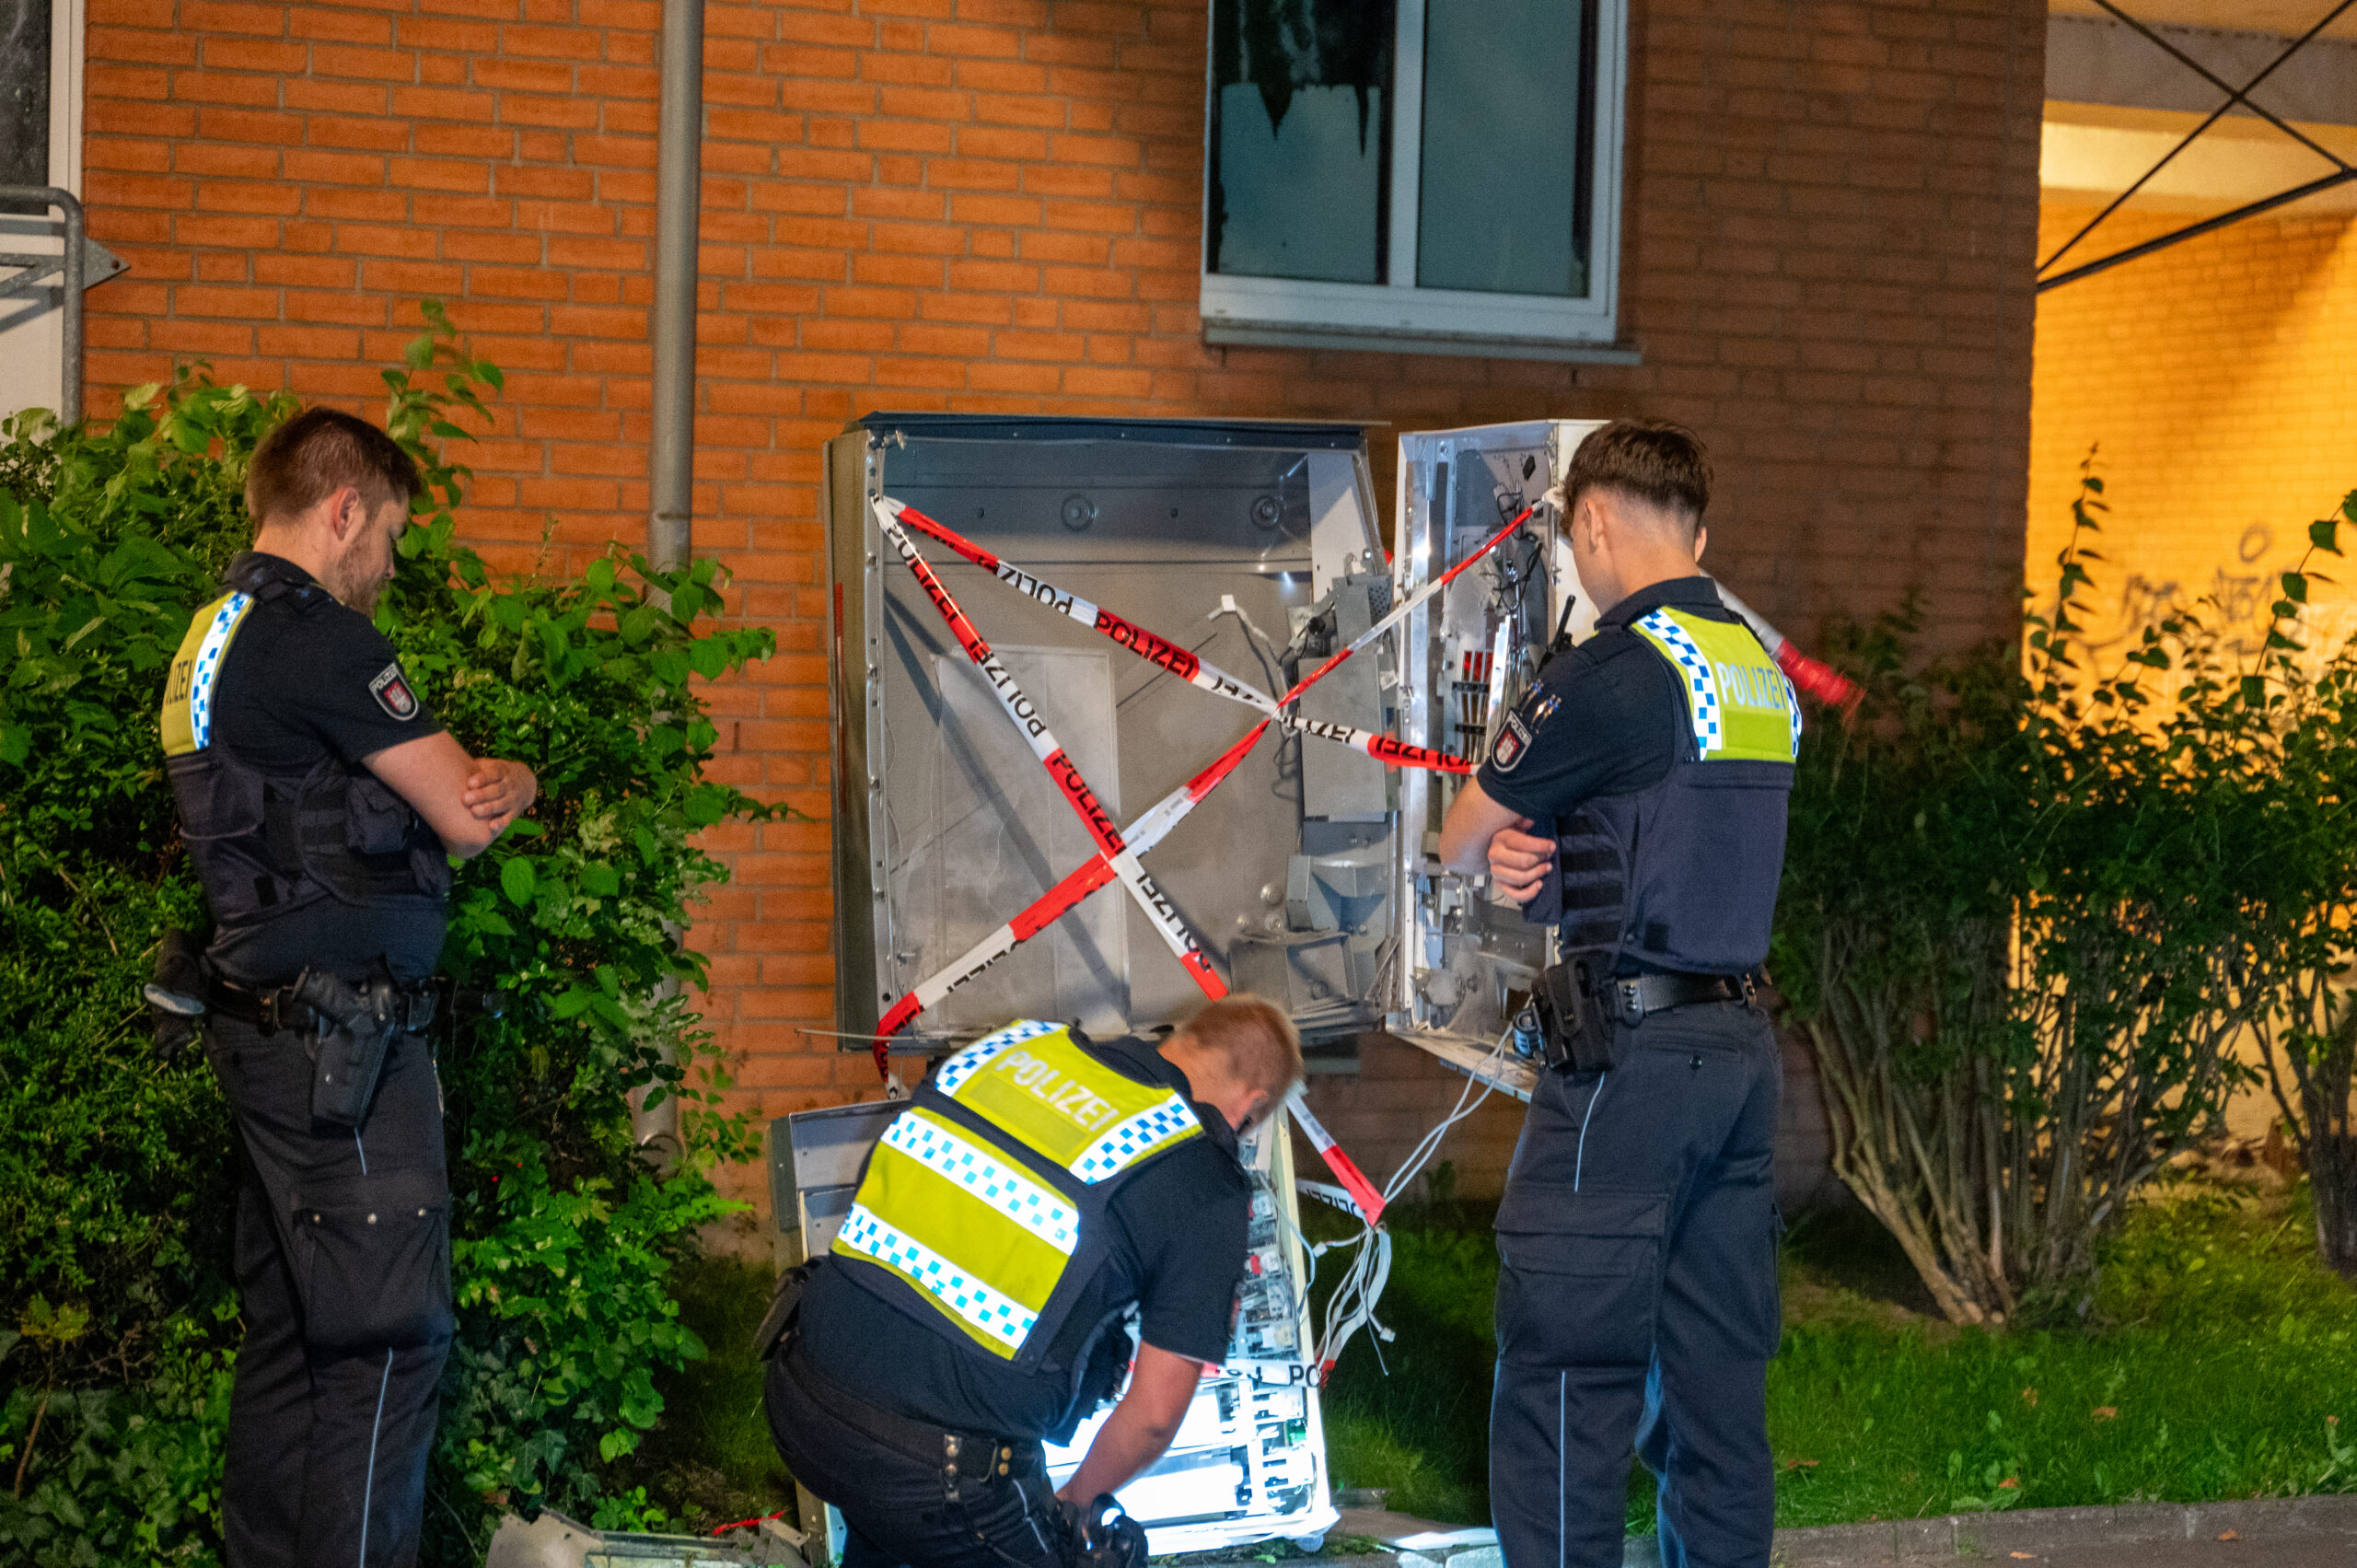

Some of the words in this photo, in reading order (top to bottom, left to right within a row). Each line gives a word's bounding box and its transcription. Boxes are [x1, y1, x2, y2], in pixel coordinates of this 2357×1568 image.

[1094, 610, 1196, 679] POLIZEI
[1714, 661, 1786, 710] POLIZEI
[970, 636, 1047, 738] POLIZEI
[1051, 752, 1127, 855] POLIZEI
[994, 1050, 1120, 1132] POLIZEI
